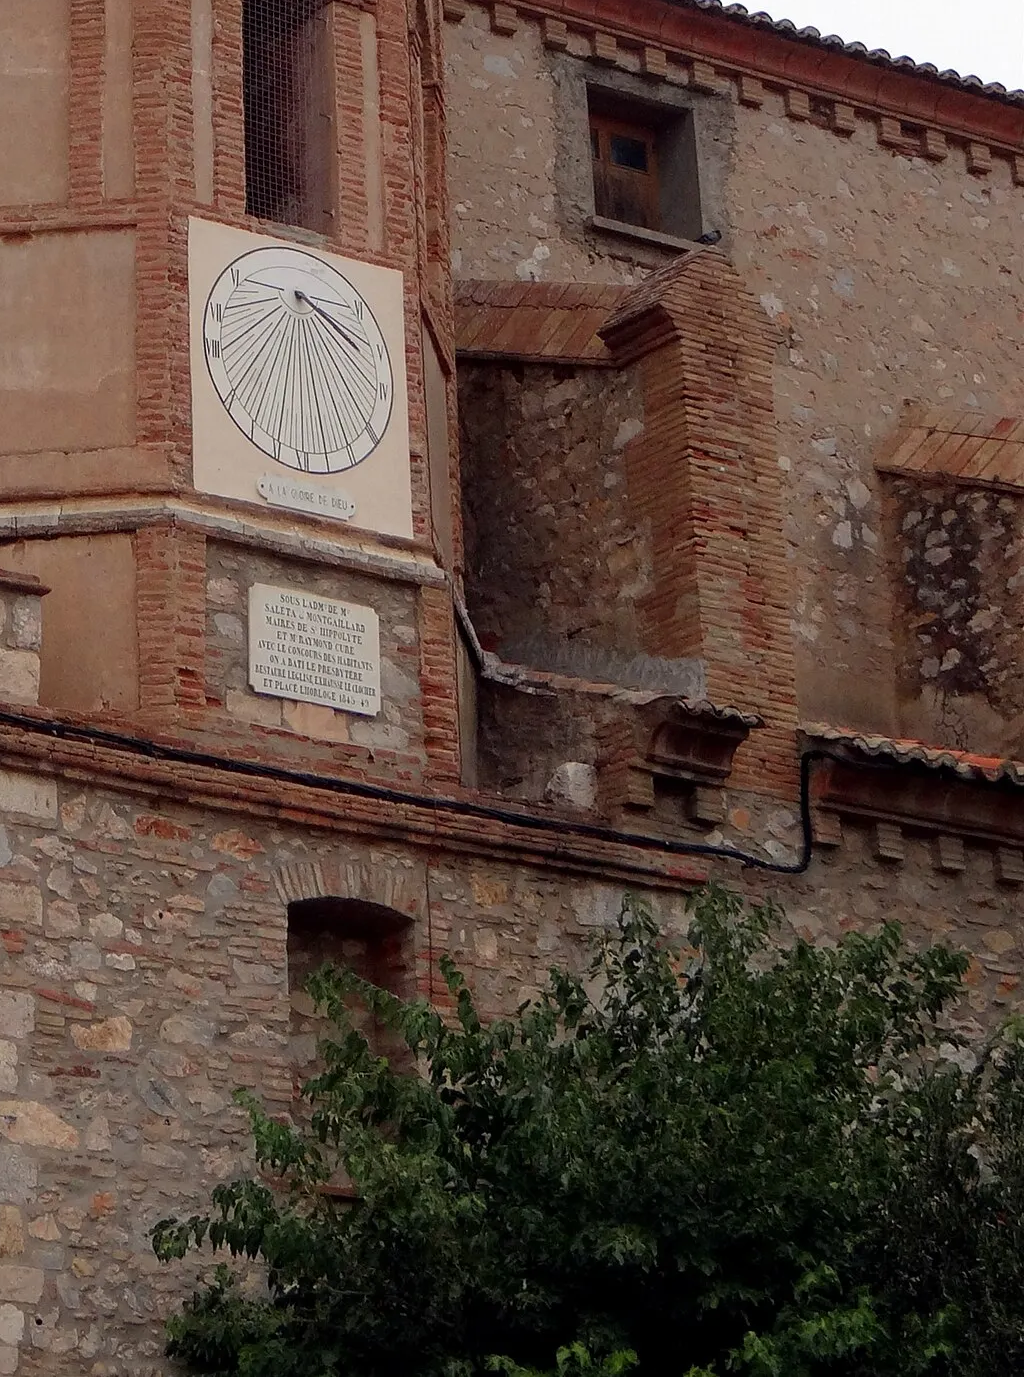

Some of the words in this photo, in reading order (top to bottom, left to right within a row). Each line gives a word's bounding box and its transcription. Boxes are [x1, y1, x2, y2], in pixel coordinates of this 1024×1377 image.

[277, 486, 288, 497] LA
[318, 494, 328, 507] DE
[331, 497, 349, 511] DIEU
[279, 593, 300, 606] SOUS
[328, 604, 339, 615] DE
[264, 603, 297, 619] SALETA
[306, 612, 366, 634] MONTGAILLARD
[265, 616, 296, 631] MAIRES
[297, 622, 308, 633] DE
[319, 627, 364, 646] HIPPOLYTE
[276, 630, 287, 641] ET
[299, 635, 333, 651] RAYMOND
[258, 639, 276, 651] AVEC
[277, 642, 287, 654] LE
[288, 646, 323, 661] CONCOURS
[323, 652, 336, 664] DES
[337, 656, 374, 672] HABITANTS
[269, 654, 280, 665] ON
[281, 658, 287, 667] A
[288, 658, 305, 670] BATI
[306, 661, 317, 673] LE
[317, 664, 363, 682] PRESBYTERE
[263, 678, 273, 689] ET
[344, 682, 352, 692] LE
[352, 684, 376, 698] CLOCHER
